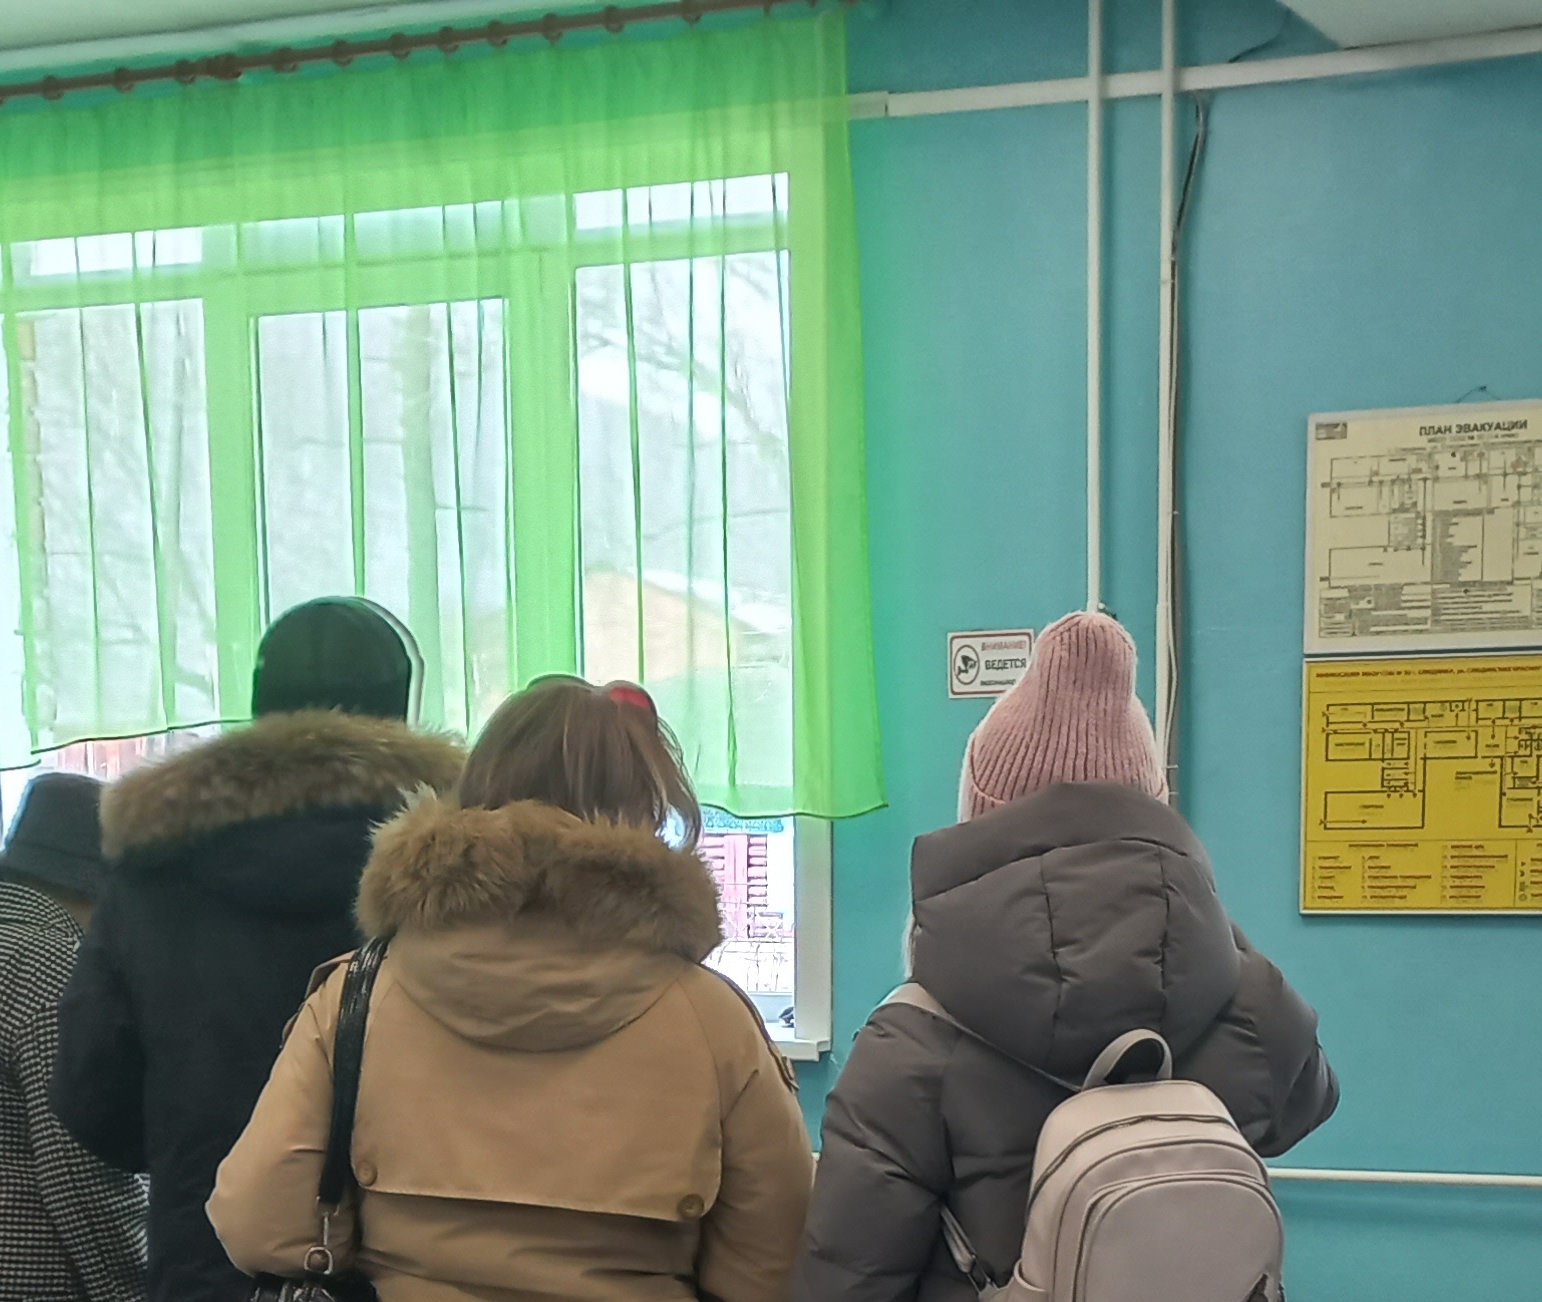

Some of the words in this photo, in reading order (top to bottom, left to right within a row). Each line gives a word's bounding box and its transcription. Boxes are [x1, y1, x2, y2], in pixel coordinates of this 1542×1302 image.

[1419, 424, 1452, 436] ПЛАН
[1455, 419, 1528, 434] ЭВАКУАЦИИ
[985, 658, 1027, 670] ВЕДЕТСЯ
